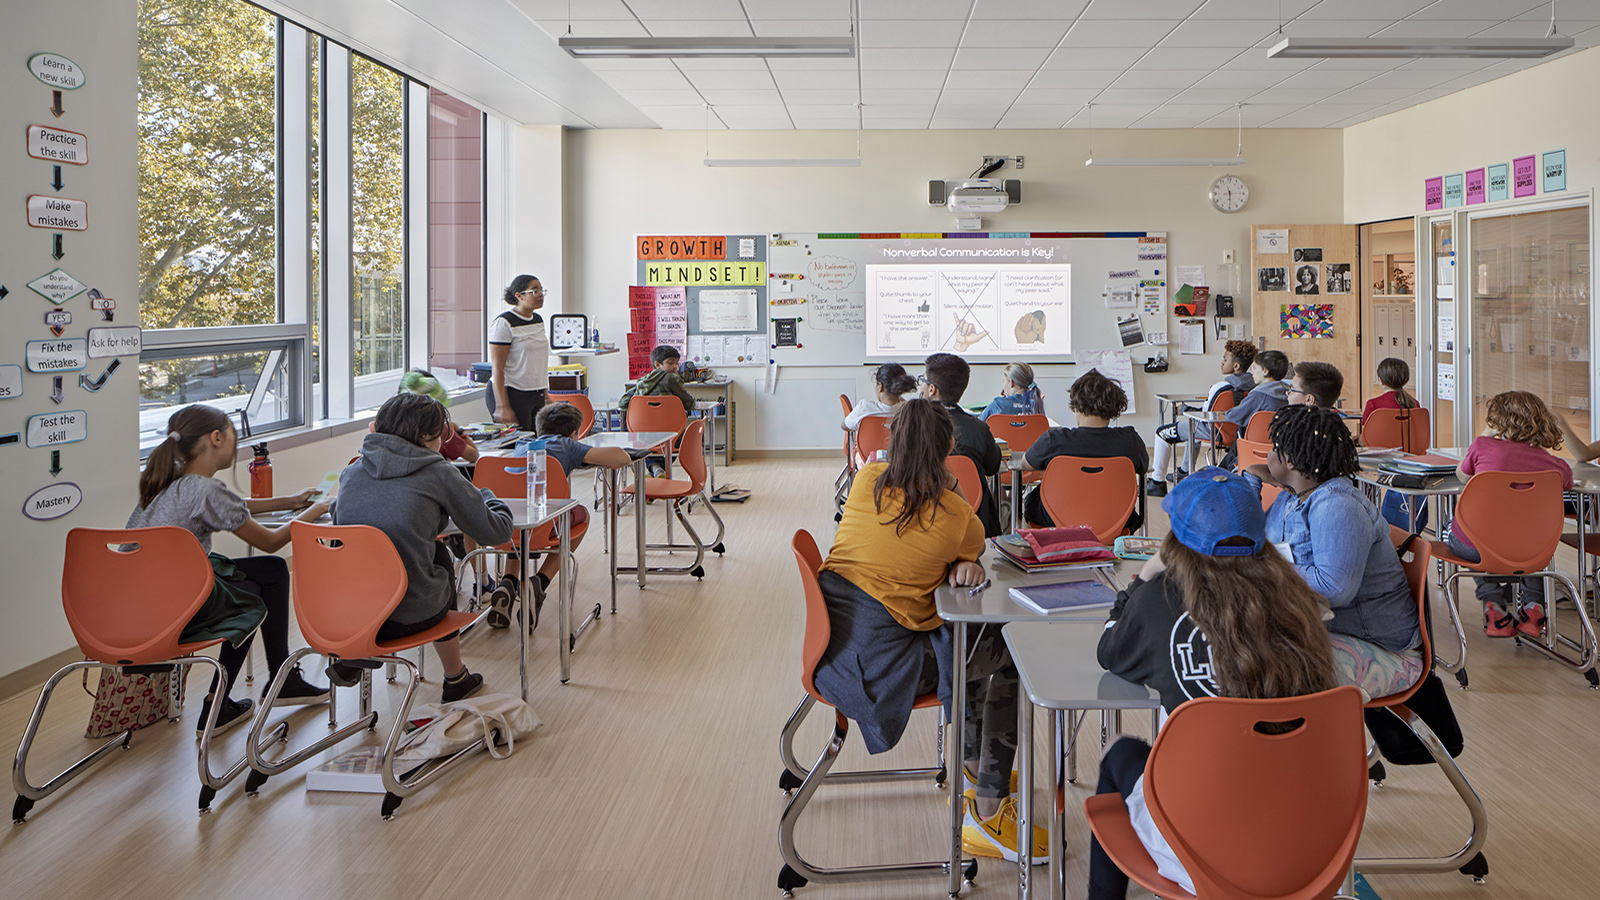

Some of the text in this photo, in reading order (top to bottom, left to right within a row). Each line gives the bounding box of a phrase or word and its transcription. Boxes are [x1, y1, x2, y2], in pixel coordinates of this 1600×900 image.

[42, 56, 73, 73] Learn a
[39, 71, 77, 87] new skill
[40, 130, 77, 146] Practice
[40, 146, 77, 161] the skill
[45, 200, 71, 212] Make
[38, 215, 79, 228] mistakes
[641, 241, 723, 256] GROWTH
[883, 248, 1054, 258] Nonverbal Communication is Key!
[649, 267, 759, 282] MINDSET!
[43, 283, 73, 291] understand
[52, 291, 66, 300] why?
[52, 314, 66, 323] YES
[41, 342, 73, 353] Fix the
[90, 336, 139, 349] Ask for help
[38, 357, 78, 370] mistakes
[39, 414, 75, 428] Test the
[48, 431, 66, 443] skill
[36, 493, 72, 510] Mastery
